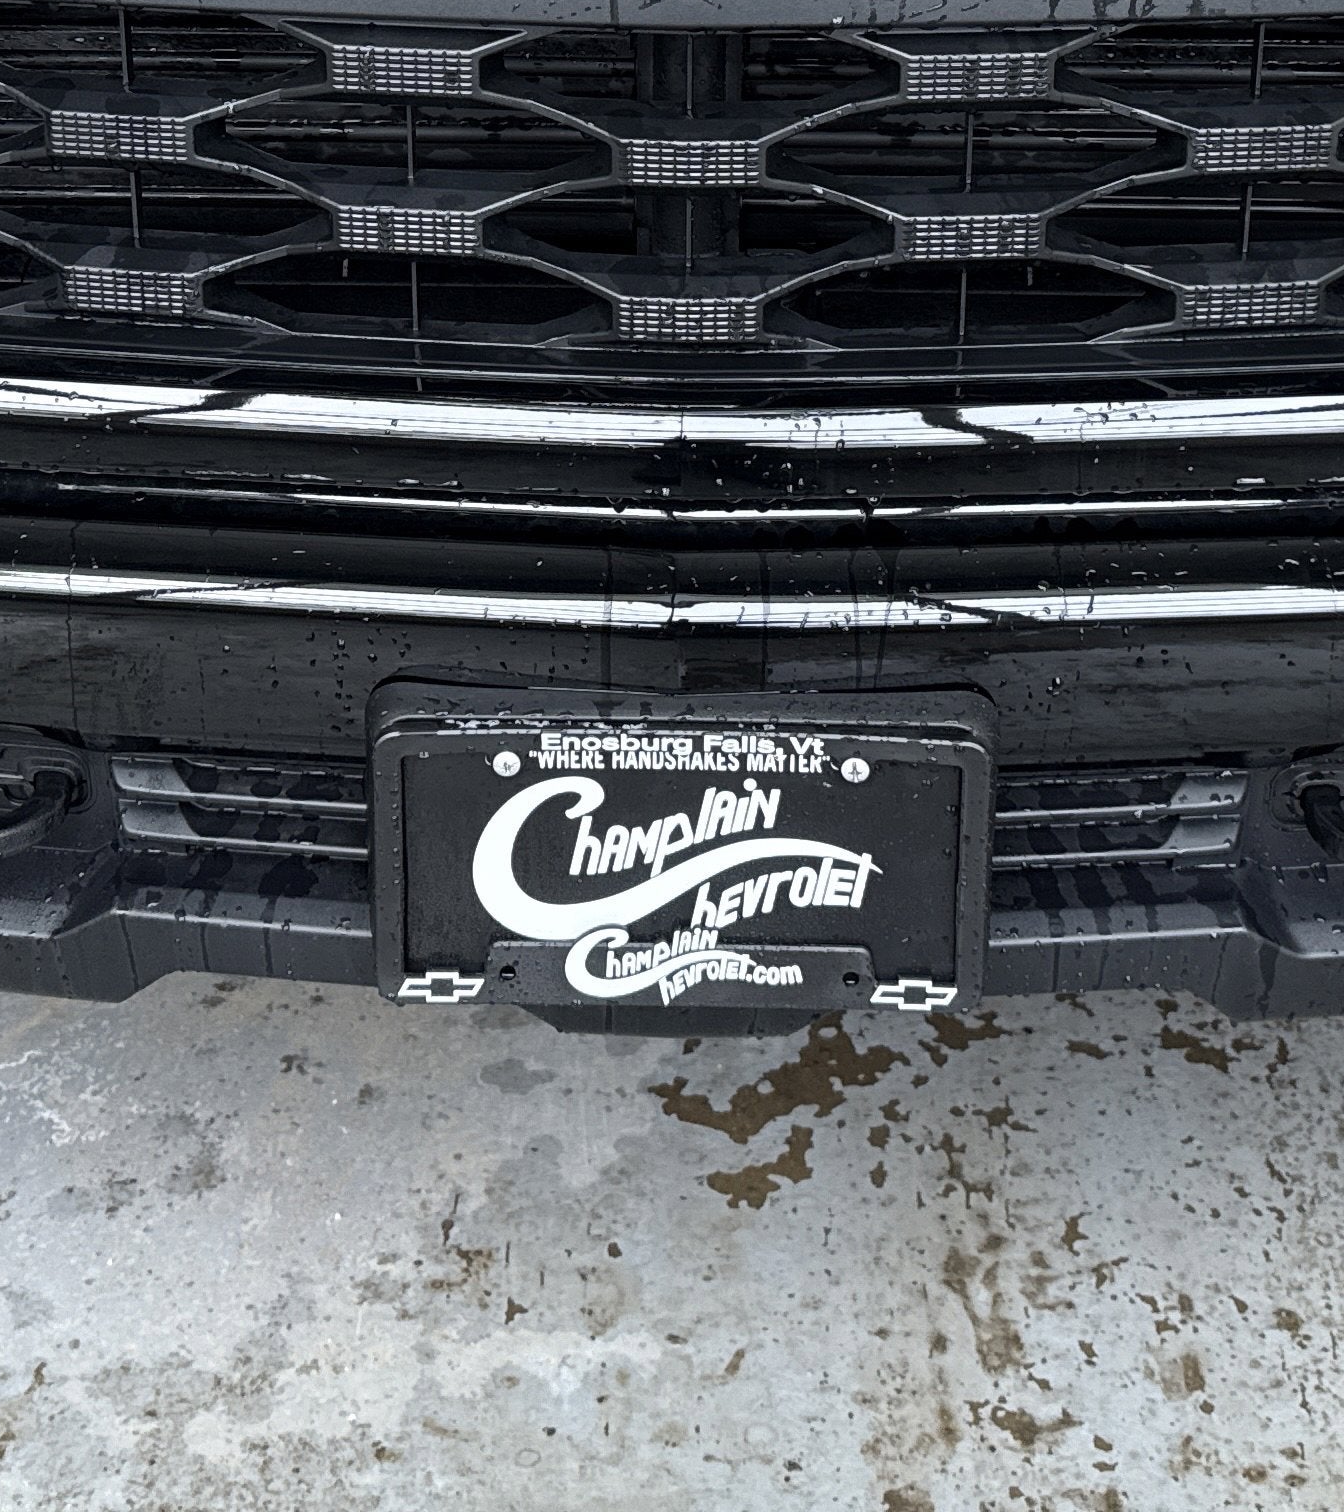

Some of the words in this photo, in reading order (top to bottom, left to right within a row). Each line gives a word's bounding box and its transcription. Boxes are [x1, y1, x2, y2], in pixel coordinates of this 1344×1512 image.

[540, 732, 693, 755] Enosburg
[703, 734, 783, 753] Falls,
[789, 737, 825, 754] Vt
[612, 750, 740, 772] HANDSHAKES
